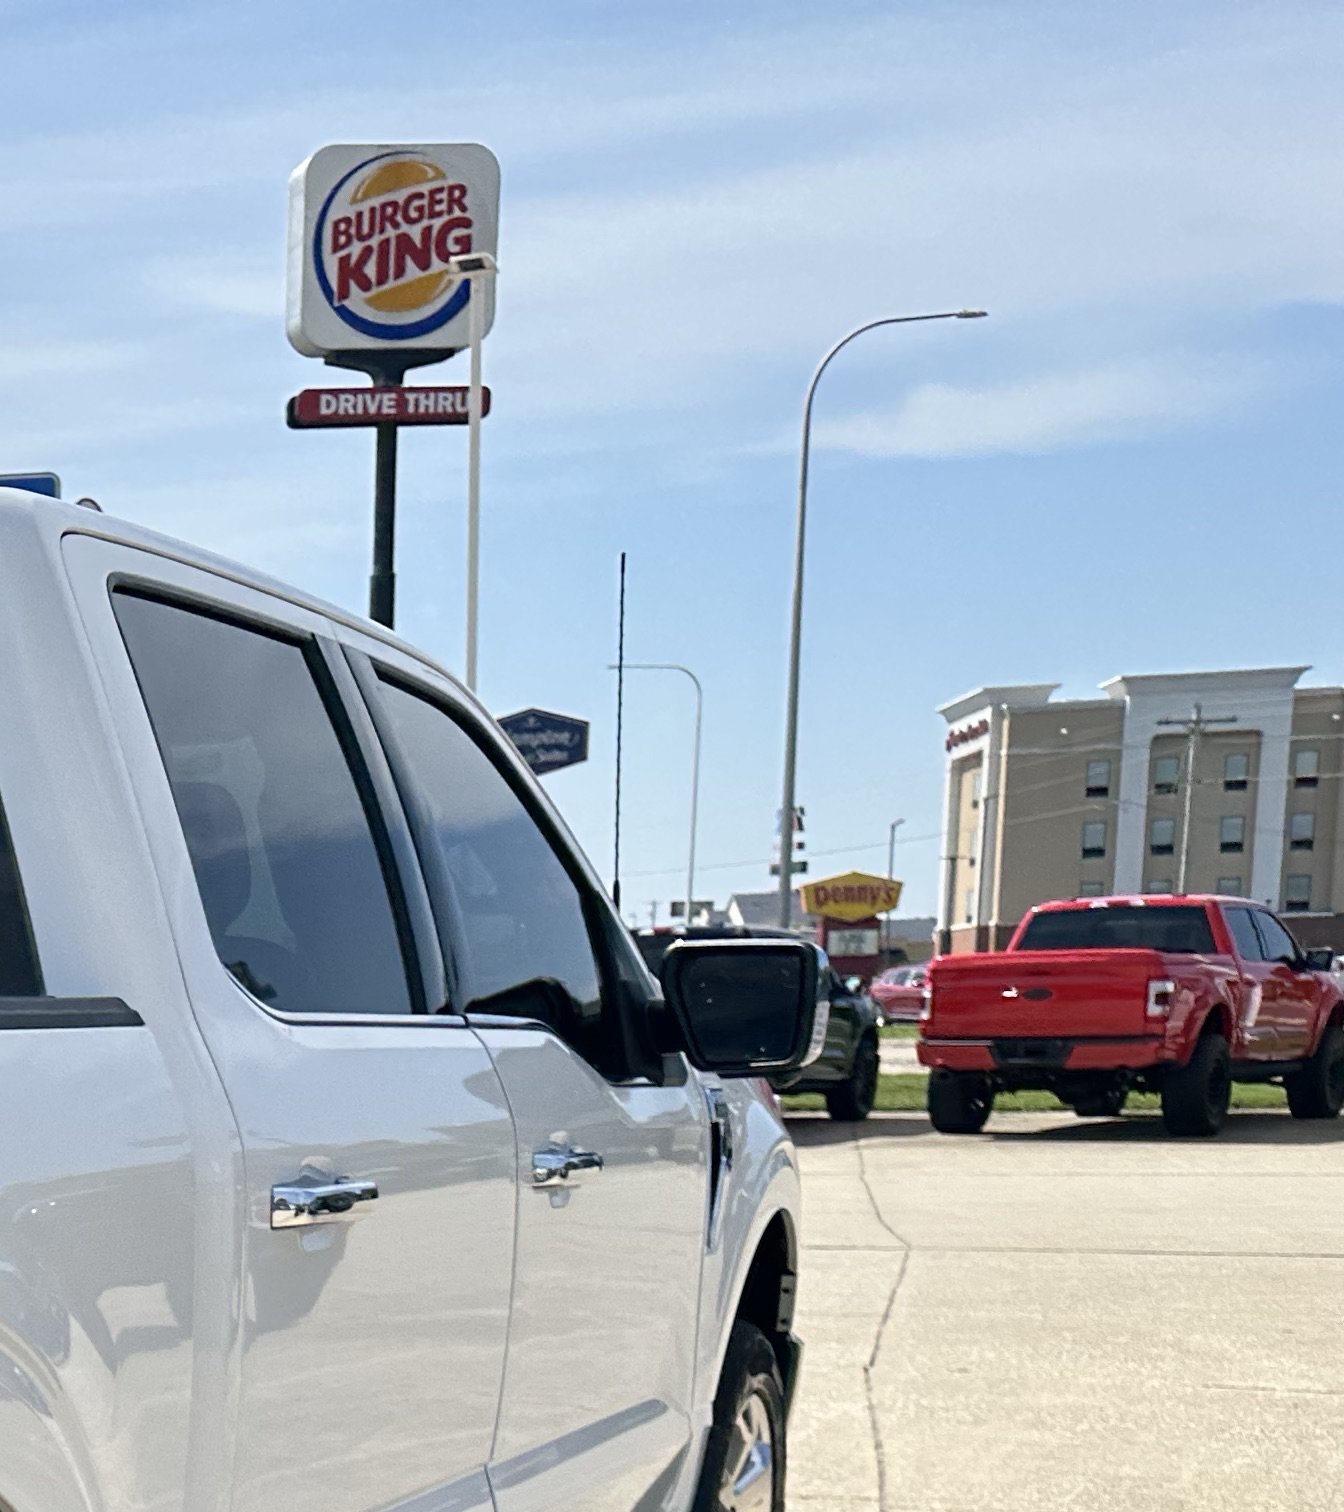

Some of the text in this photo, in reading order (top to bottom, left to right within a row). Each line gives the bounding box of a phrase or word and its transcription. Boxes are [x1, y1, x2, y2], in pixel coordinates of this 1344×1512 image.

[331, 183, 468, 254] BURGER
[336, 216, 473, 303] KING
[319, 393, 397, 415] DRIVE
